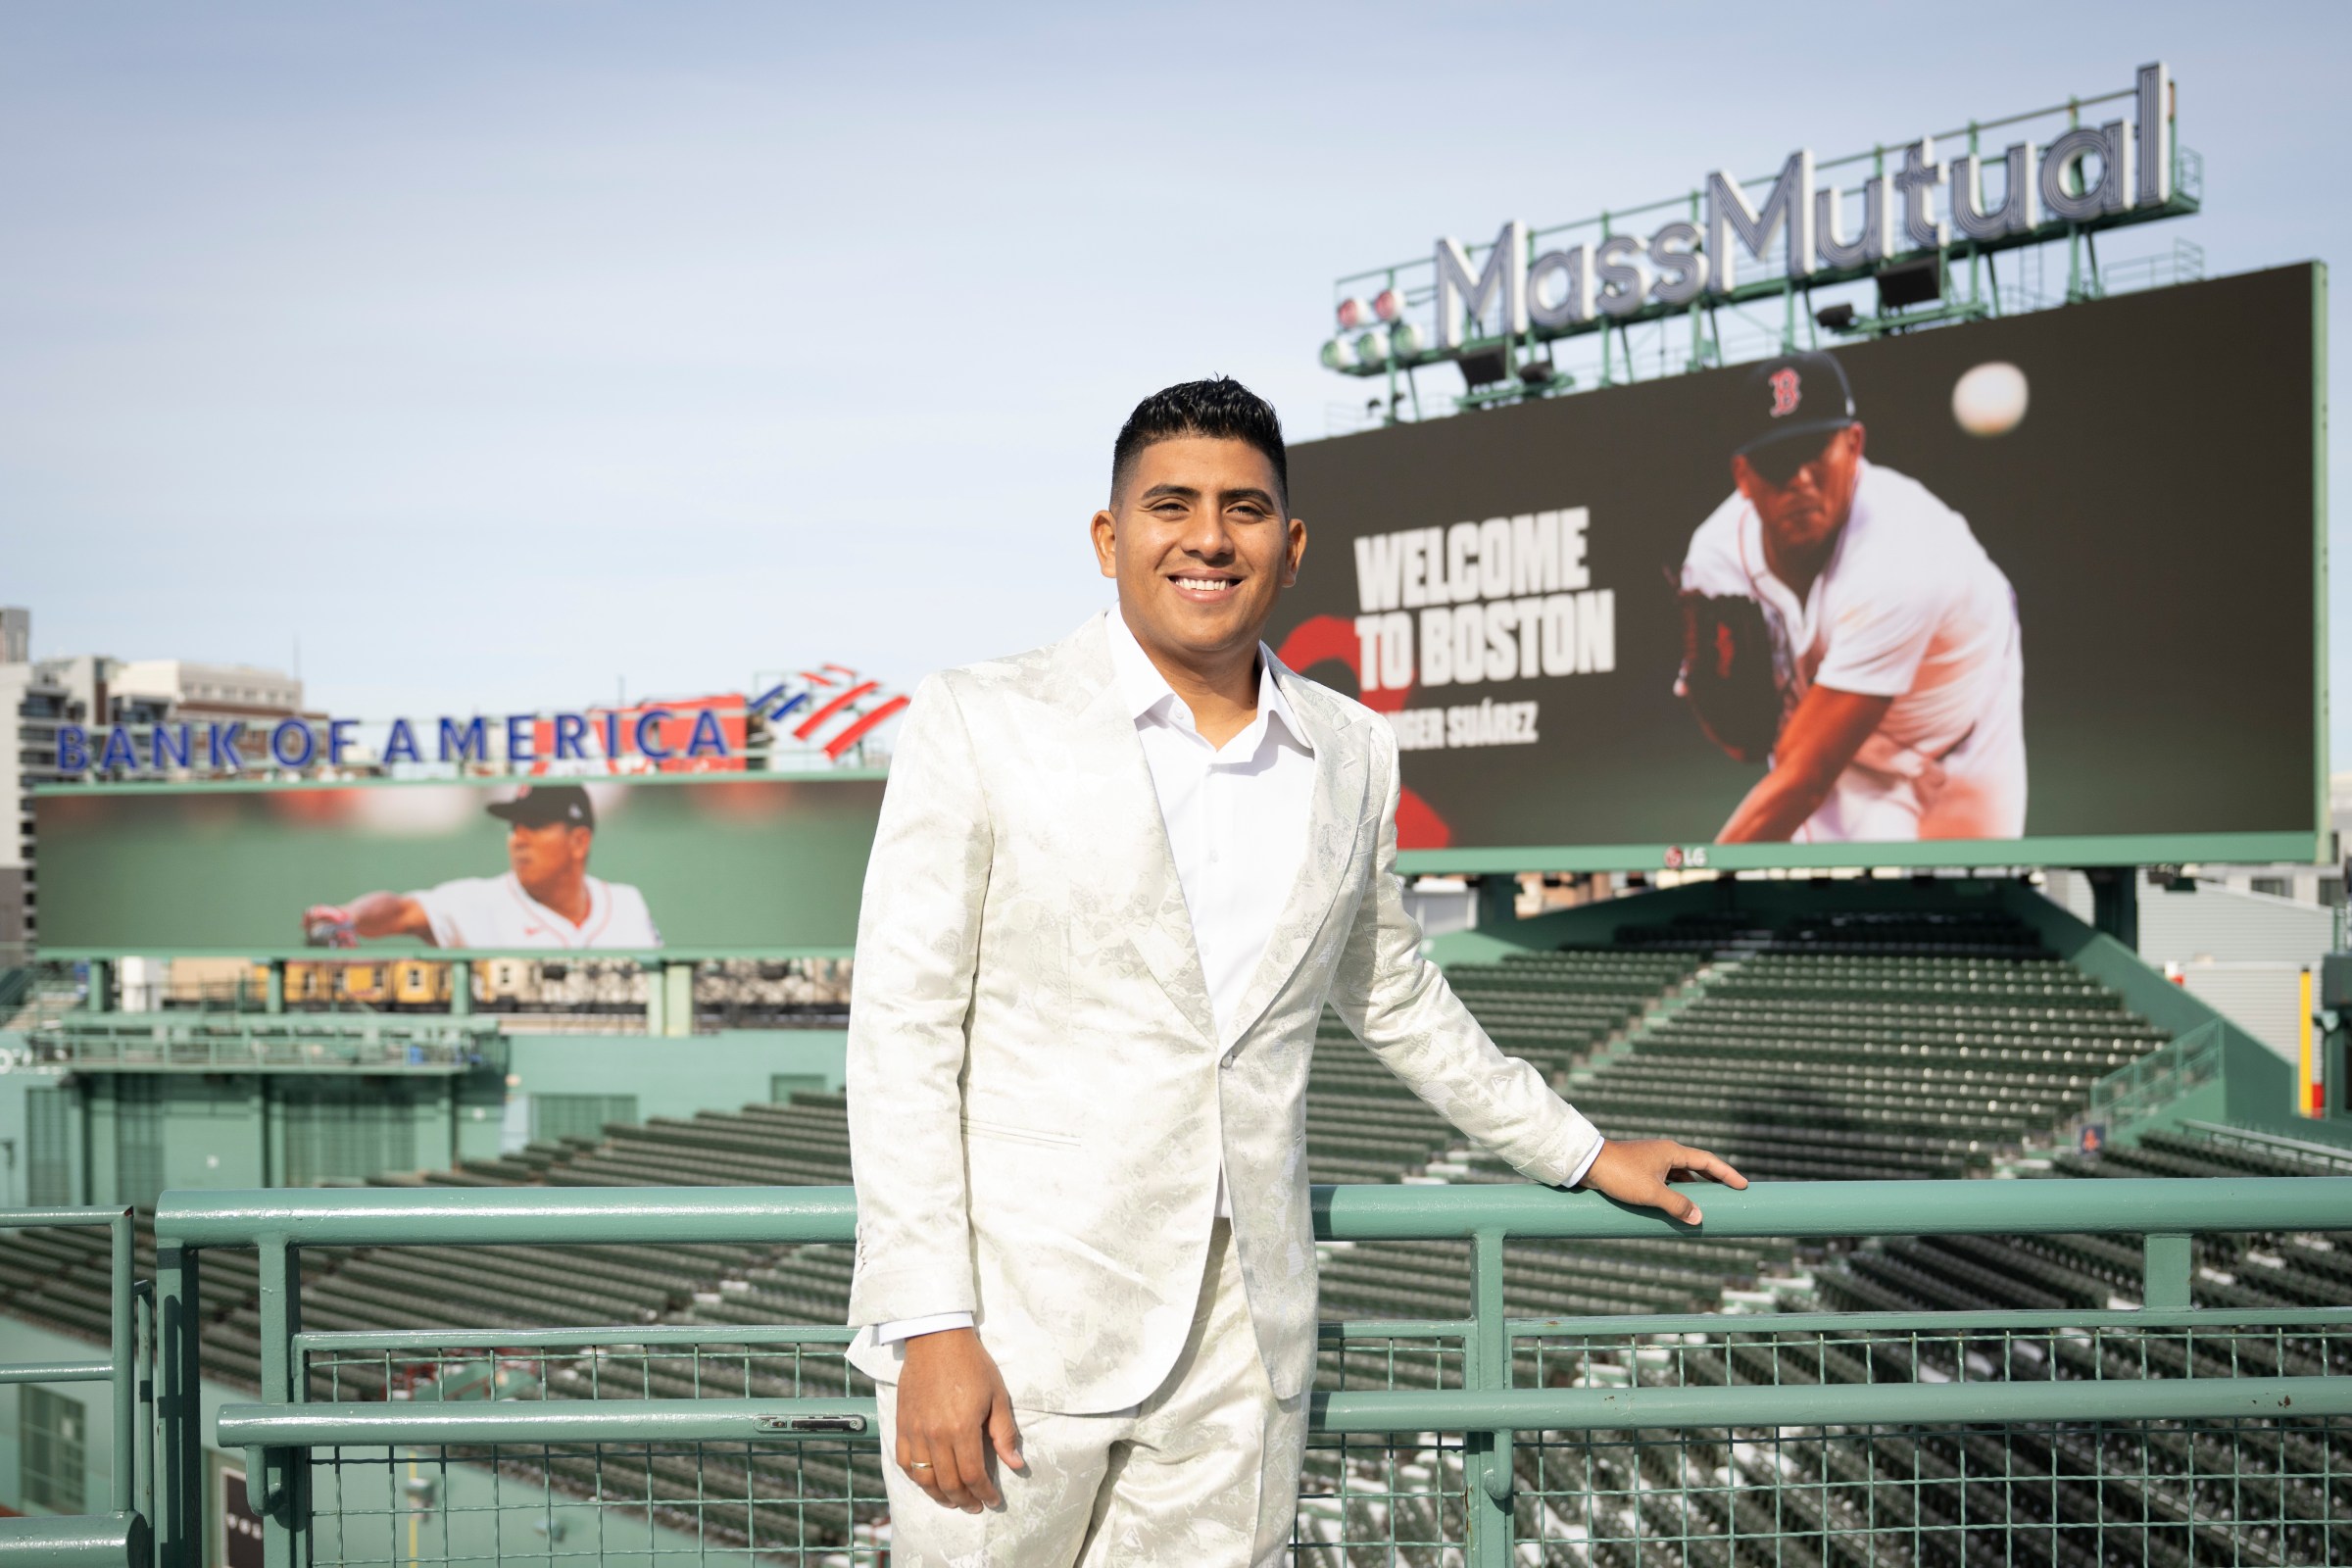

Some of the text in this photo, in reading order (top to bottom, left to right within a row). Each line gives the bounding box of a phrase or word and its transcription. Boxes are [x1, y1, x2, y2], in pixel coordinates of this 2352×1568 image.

[1435, 62, 2172, 347] MassMutual
[1769, 368, 1801, 417] B
[1354, 507, 1590, 612] WELCOME
[1355, 589, 1615, 691] TO BOSTON
[57, 710, 727, 773] BANK OF AMERICA
[1446, 697, 1539, 748] SUÁREZ
[1684, 847, 1707, 867] LG
